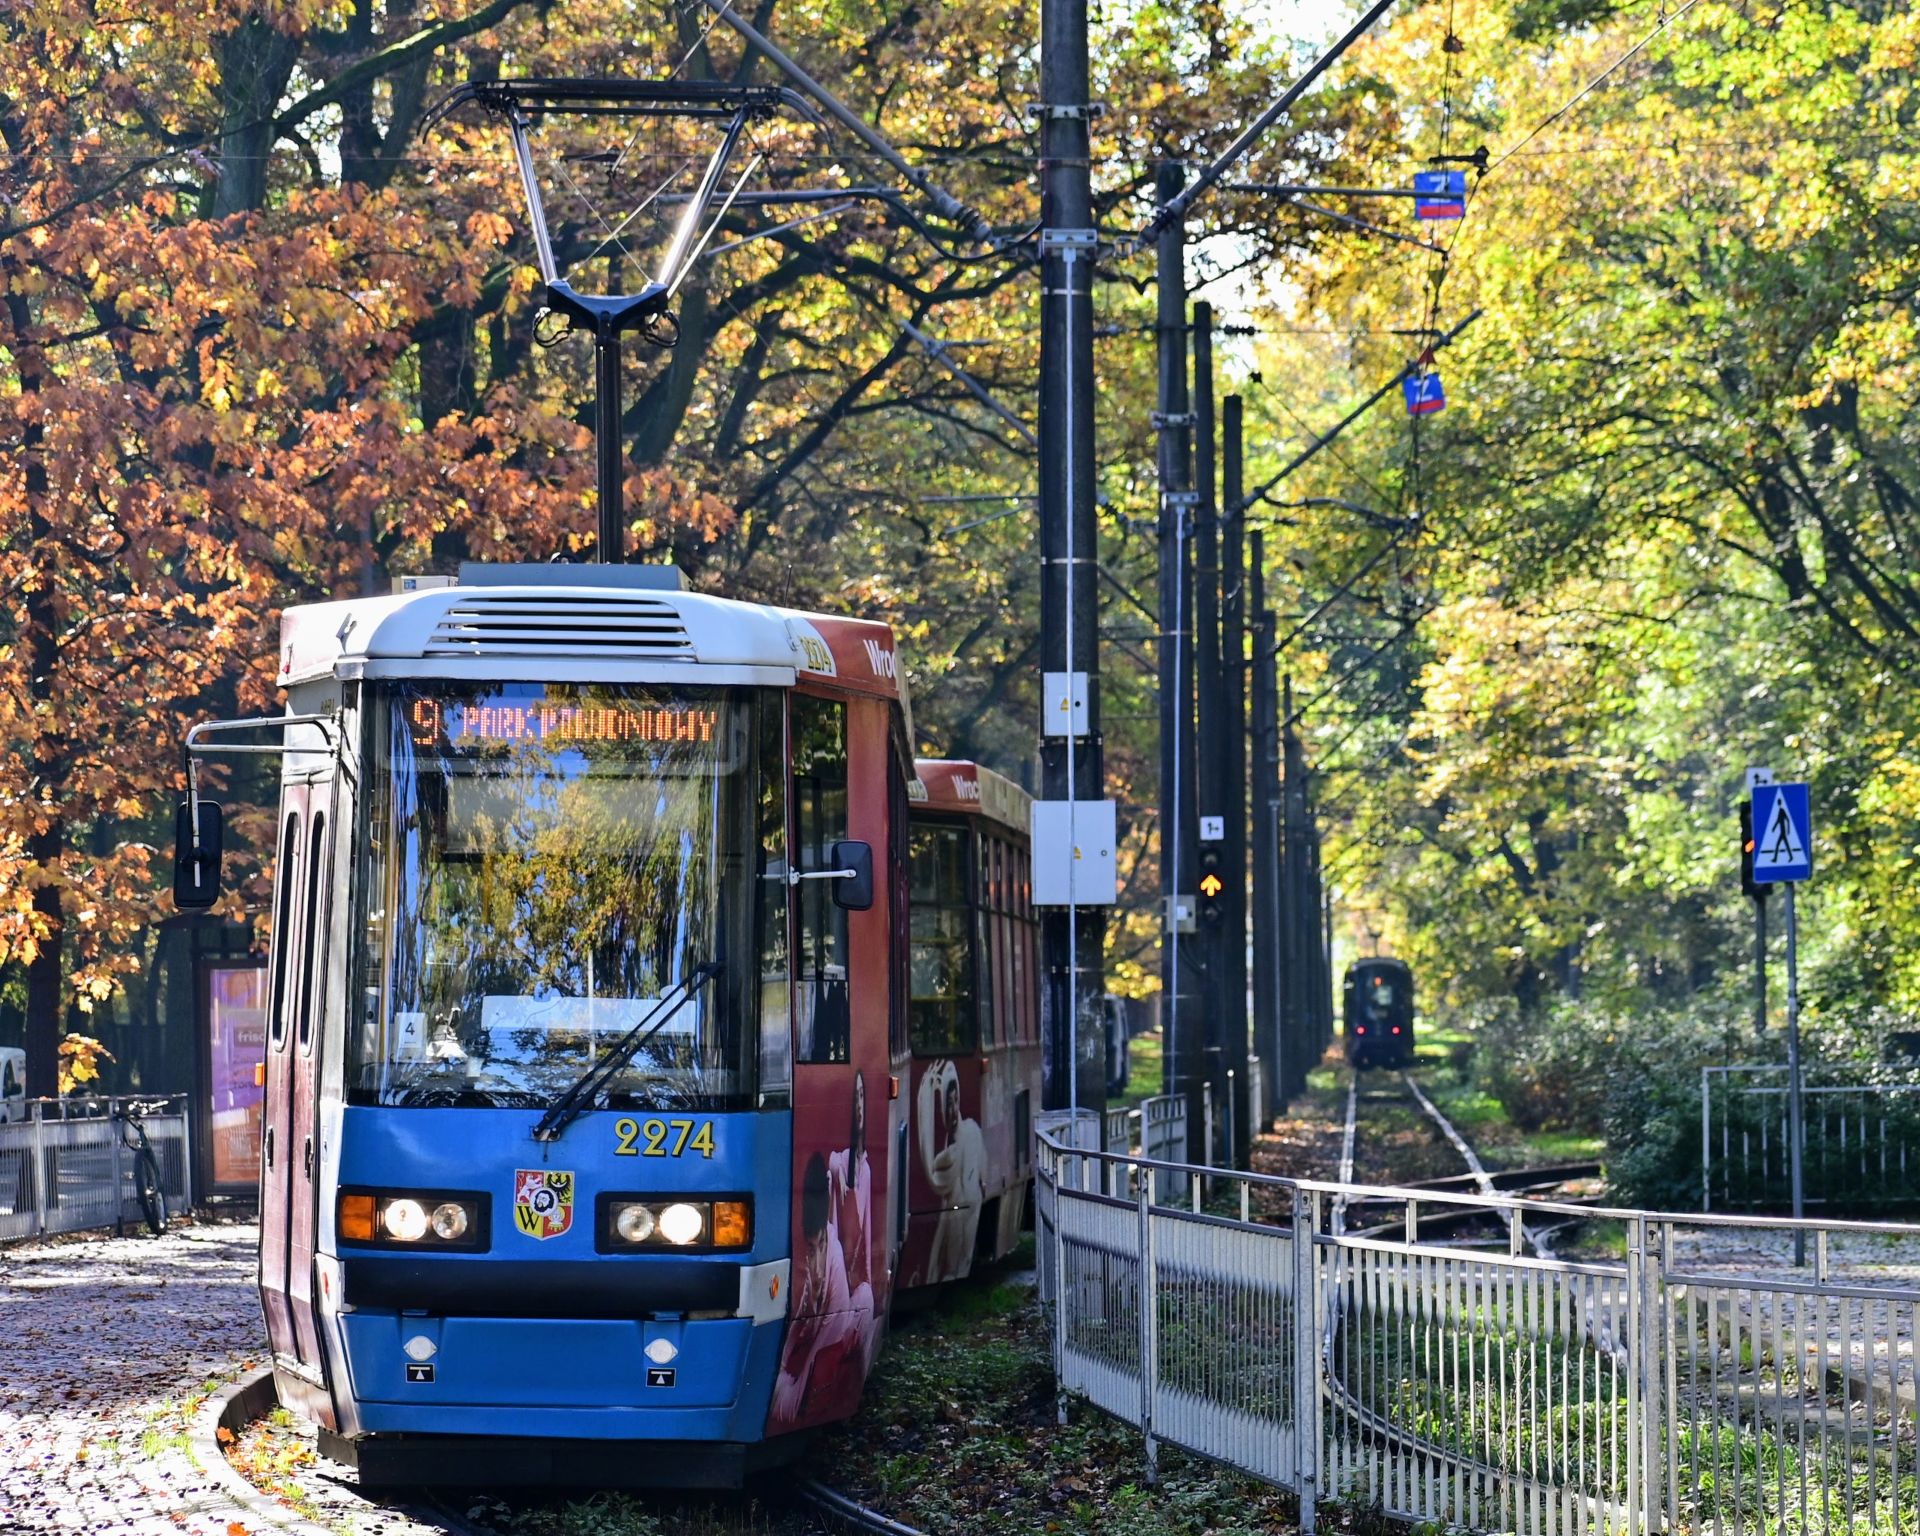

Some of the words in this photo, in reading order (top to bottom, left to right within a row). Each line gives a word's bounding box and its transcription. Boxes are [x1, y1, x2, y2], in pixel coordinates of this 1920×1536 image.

[413, 699, 439, 745] 9
[405, 1021, 416, 1036] 4
[613, 1117, 715, 1160] 2274
